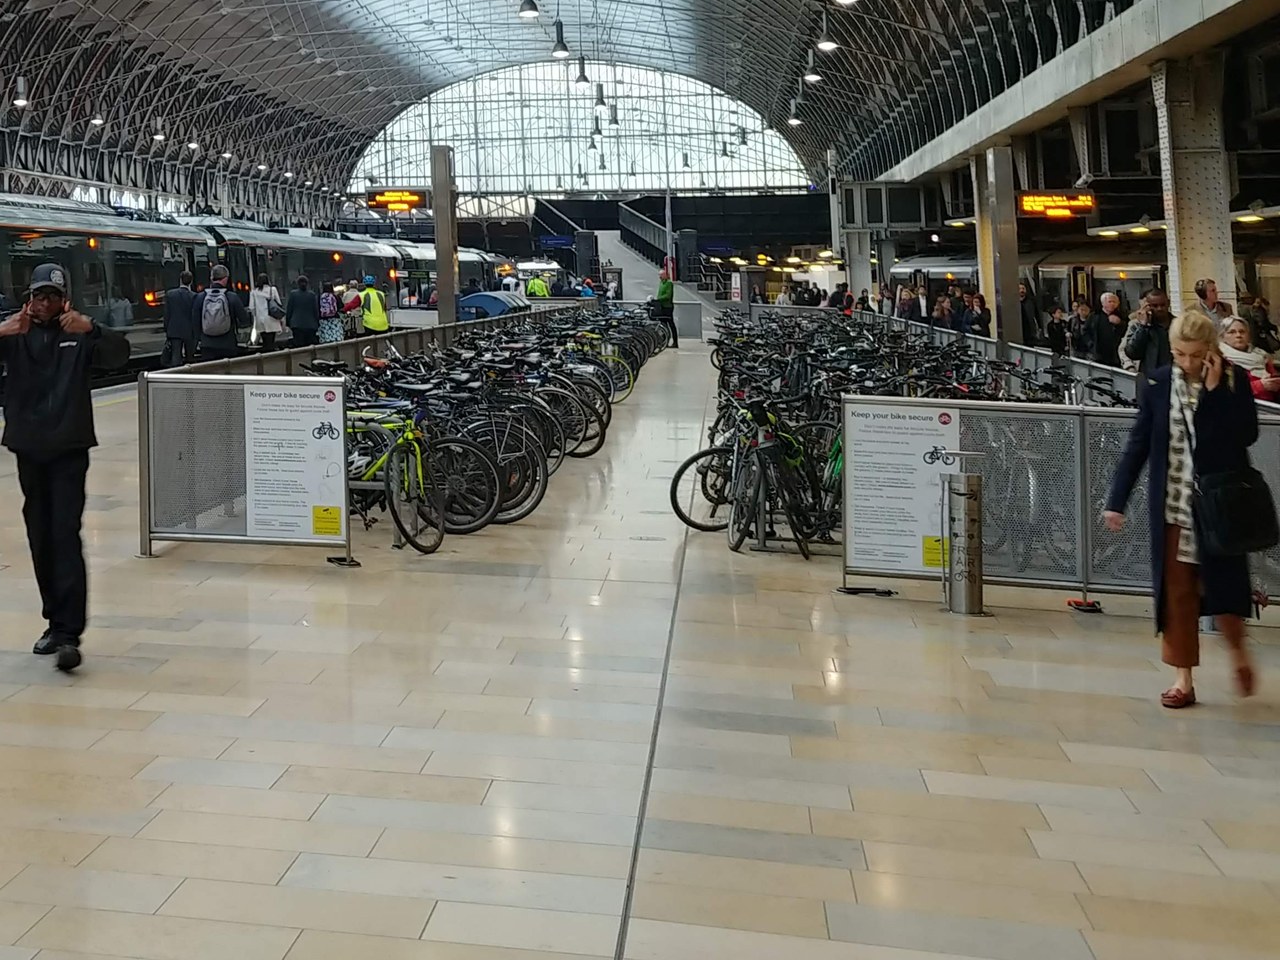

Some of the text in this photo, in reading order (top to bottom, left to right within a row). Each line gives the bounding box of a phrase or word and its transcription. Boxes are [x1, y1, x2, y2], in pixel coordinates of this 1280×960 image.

[249, 391, 267, 399] Keep
[268, 392, 282, 400] your
[851, 411, 871, 419] Keep
[908, 414, 934, 422] secure
